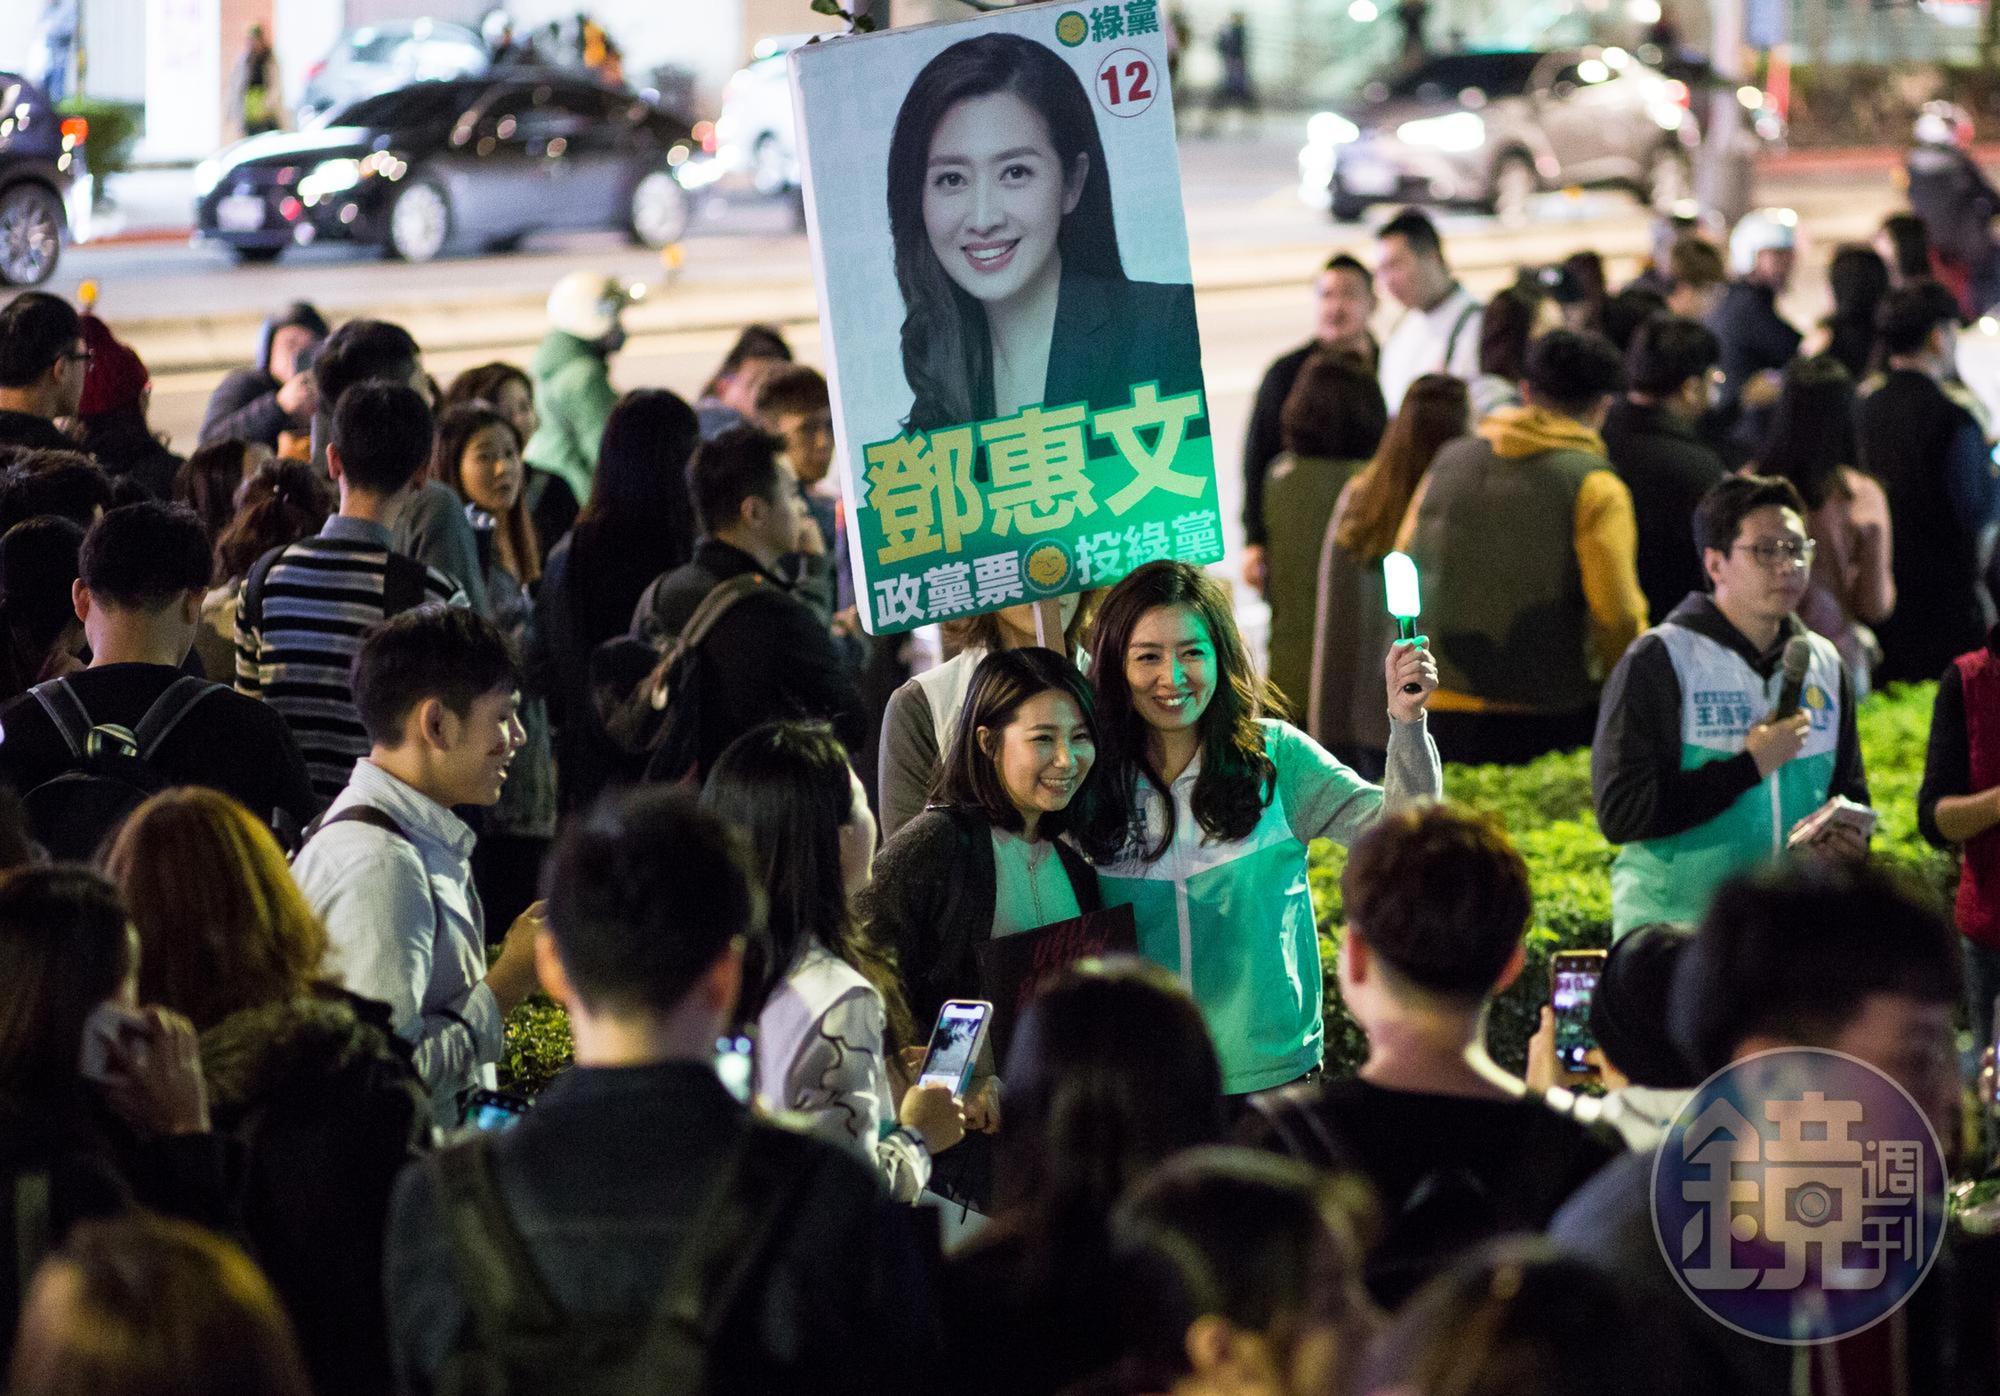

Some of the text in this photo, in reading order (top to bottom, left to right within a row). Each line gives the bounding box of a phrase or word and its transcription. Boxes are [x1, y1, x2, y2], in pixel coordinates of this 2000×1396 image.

[1089, 0, 1159, 42] 綠黨
[1100, 61, 1151, 105] 12
[868, 384, 1208, 565] 鄧惠文
[873, 509, 1221, 628] 政黨票 投綠黨
